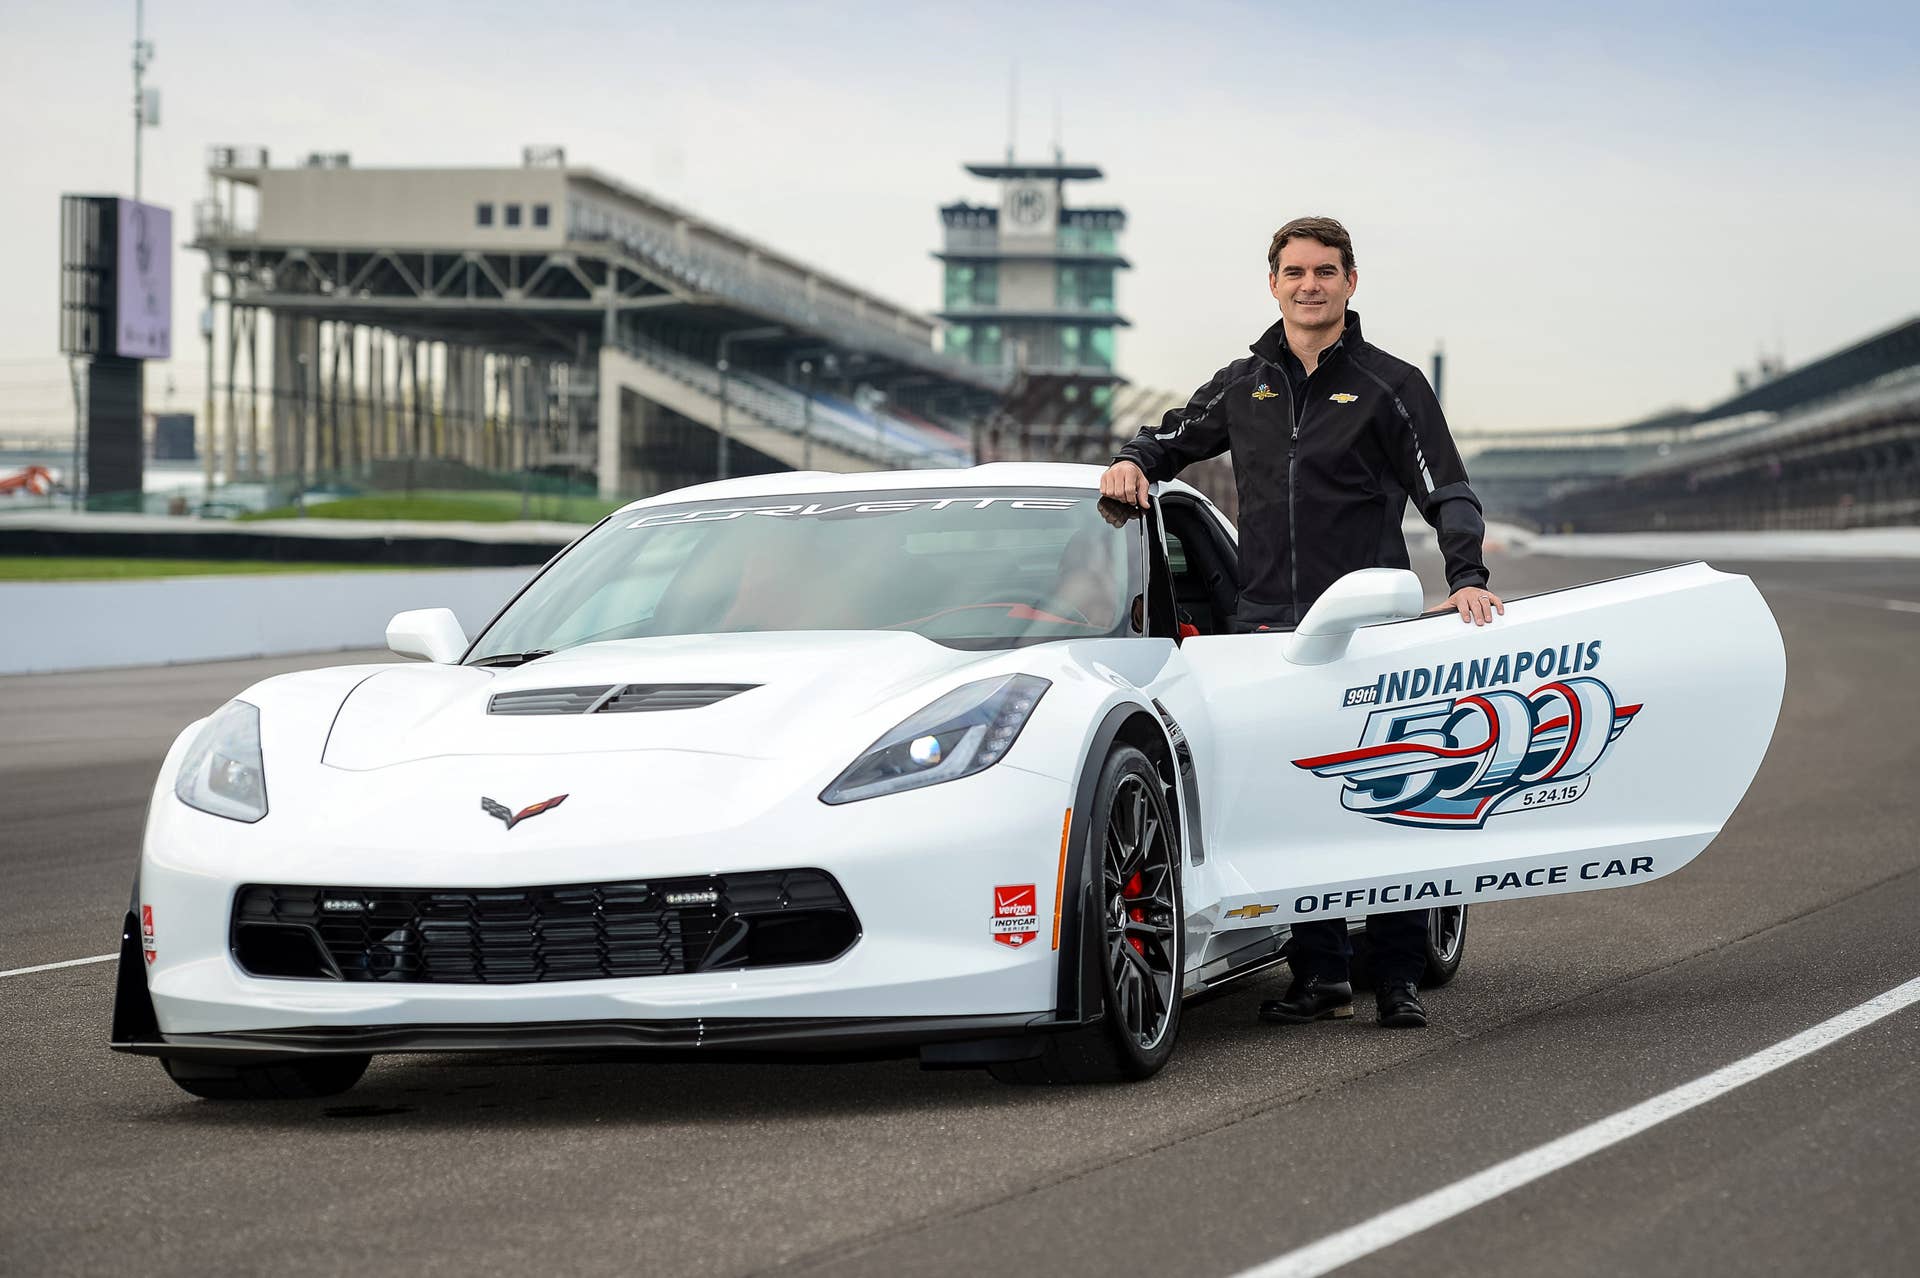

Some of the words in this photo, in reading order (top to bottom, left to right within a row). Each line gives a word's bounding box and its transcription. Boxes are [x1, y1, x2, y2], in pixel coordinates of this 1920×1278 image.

[626, 498, 1081, 530] CORVETTE
[1347, 686, 1378, 705] 99th
[1374, 640, 1602, 705] INDIANAPOLIS
[1338, 676, 1617, 815] 500
[1523, 785, 1578, 806] 5.24.15
[1294, 879, 1463, 914] OFFICIAL
[1474, 865, 1569, 893] PACE
[1580, 856, 1655, 880] CAR
[994, 918, 1036, 927] INDYCAR
[998, 903, 1033, 916] verizon
